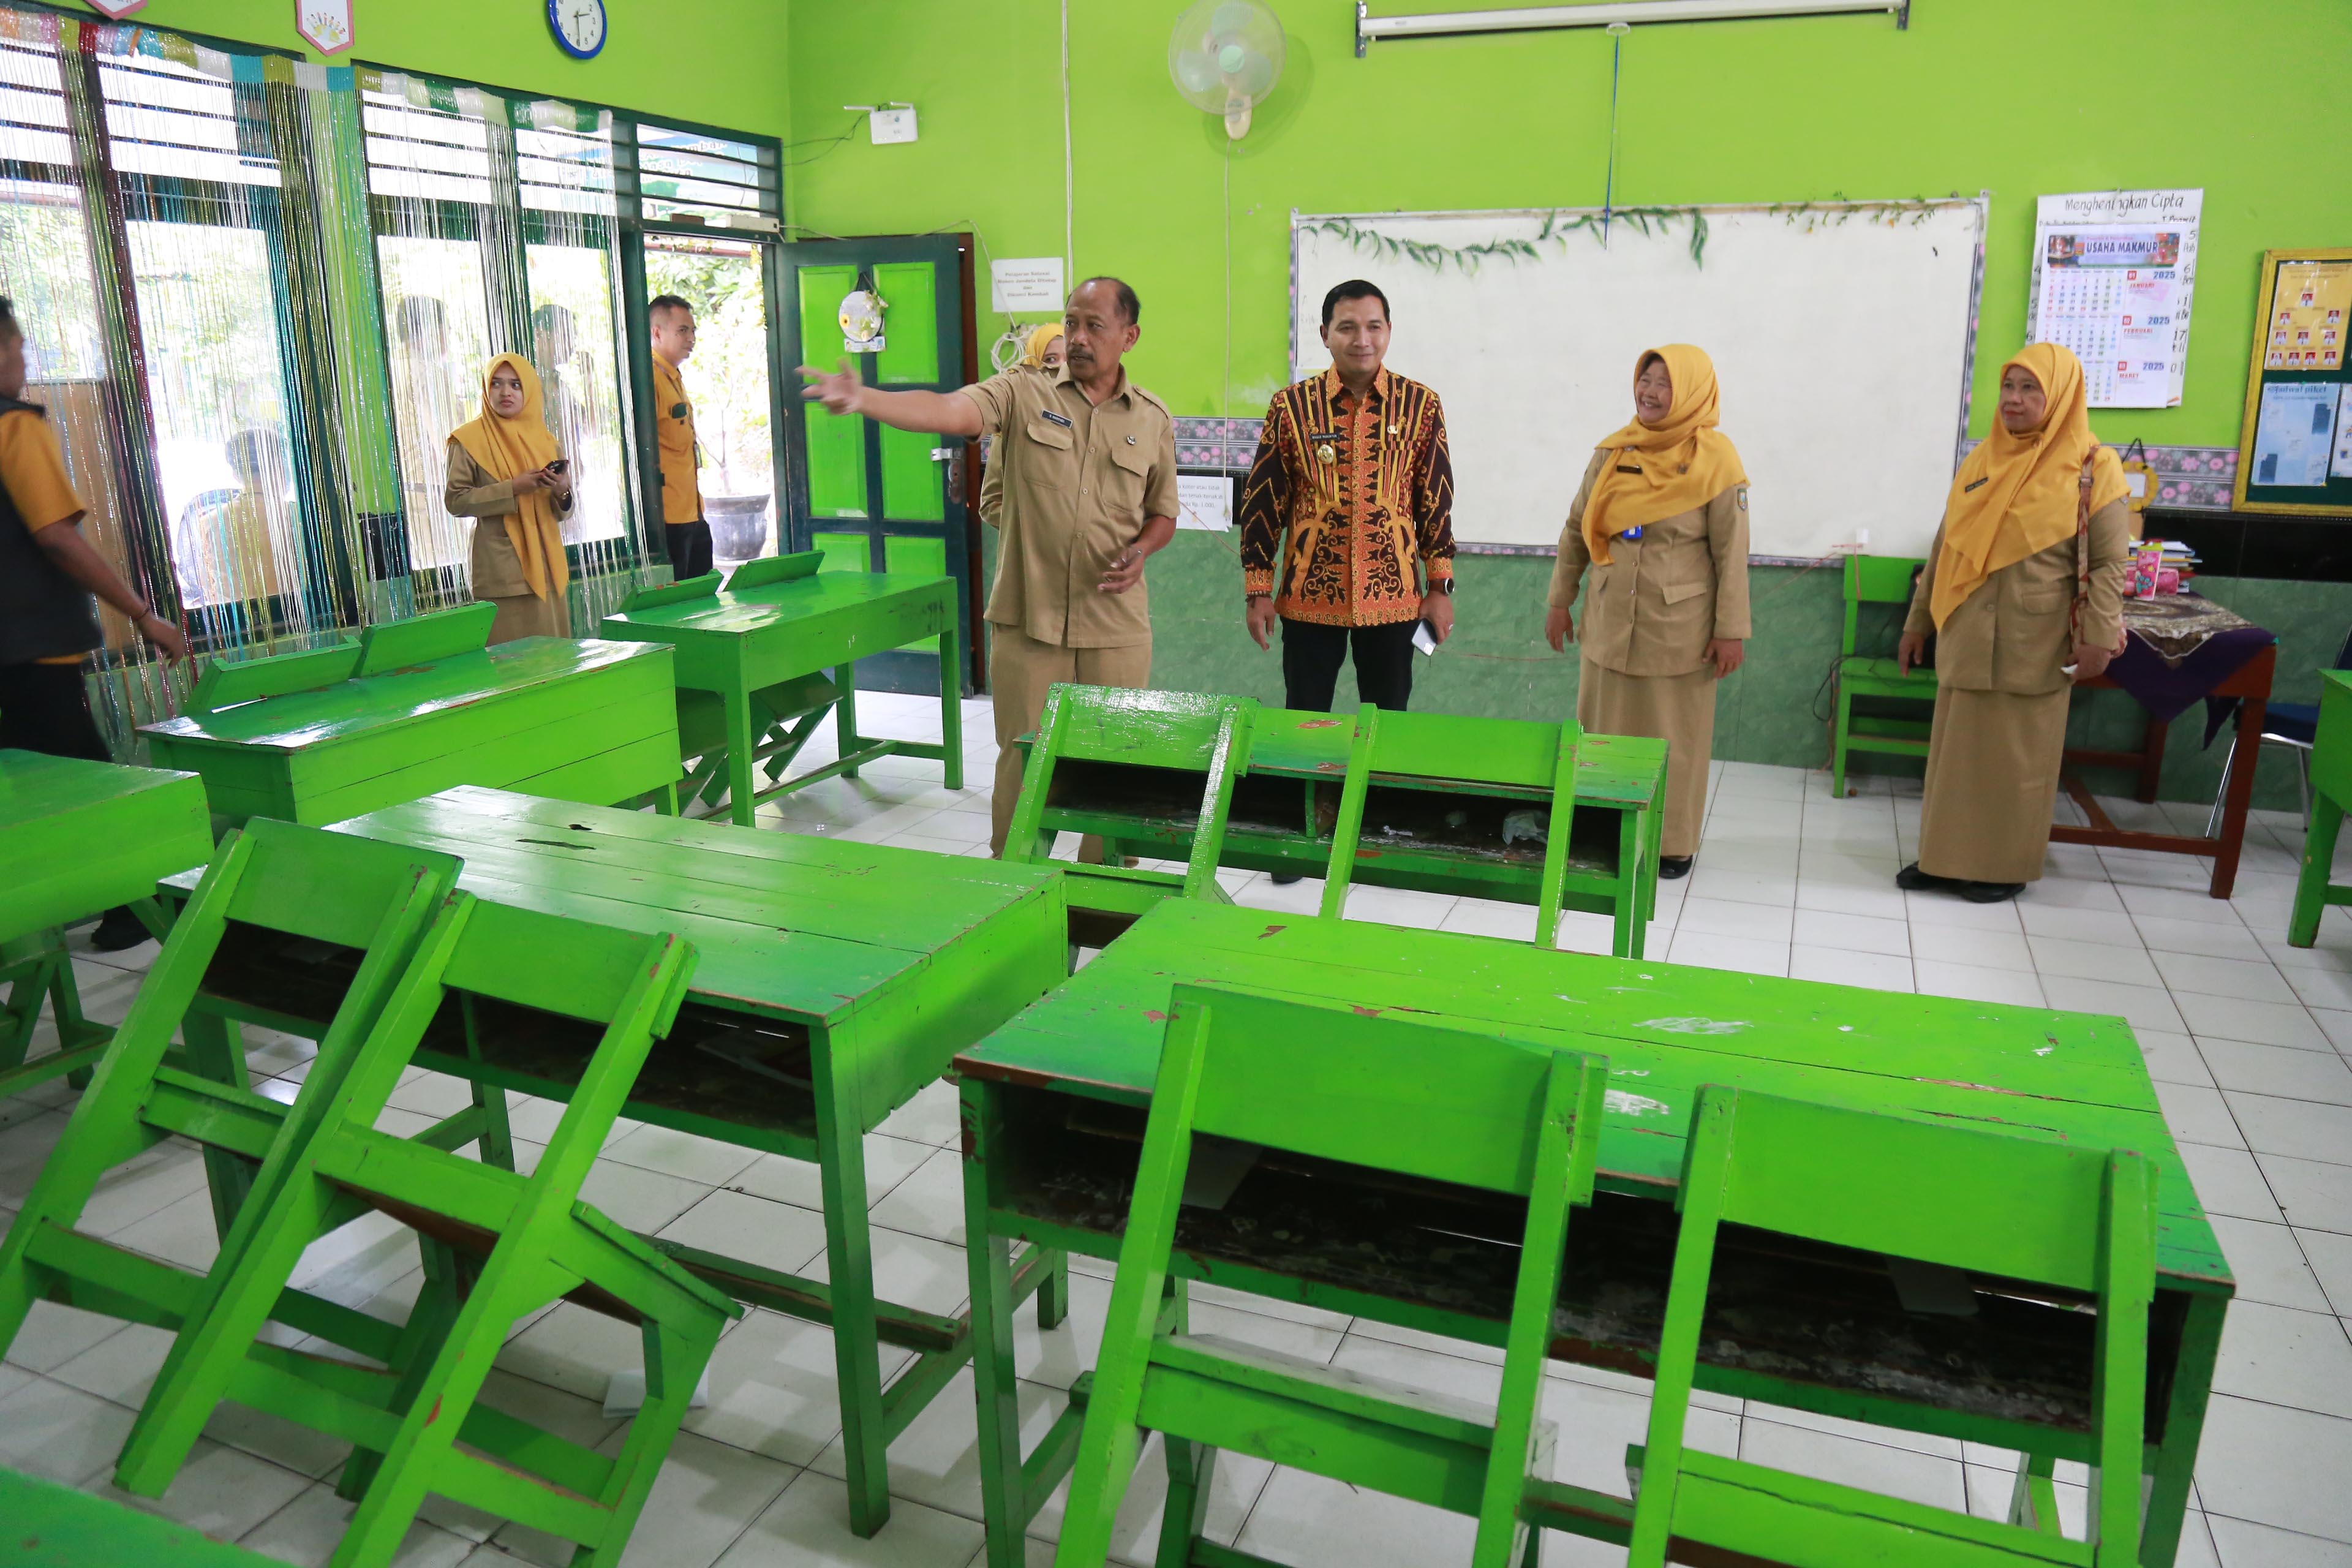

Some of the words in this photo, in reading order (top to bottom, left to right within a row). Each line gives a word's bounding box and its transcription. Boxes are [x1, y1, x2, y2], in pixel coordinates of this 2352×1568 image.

[2151, 193, 2184, 212] Cipta
[2087, 242, 2114, 254] USAHA
[2118, 241, 2158, 254] MAKMUR
[2154, 271, 2176, 279] 2025
[2148, 317, 2170, 325] 2025
[2143, 362, 2164, 371] 2025
